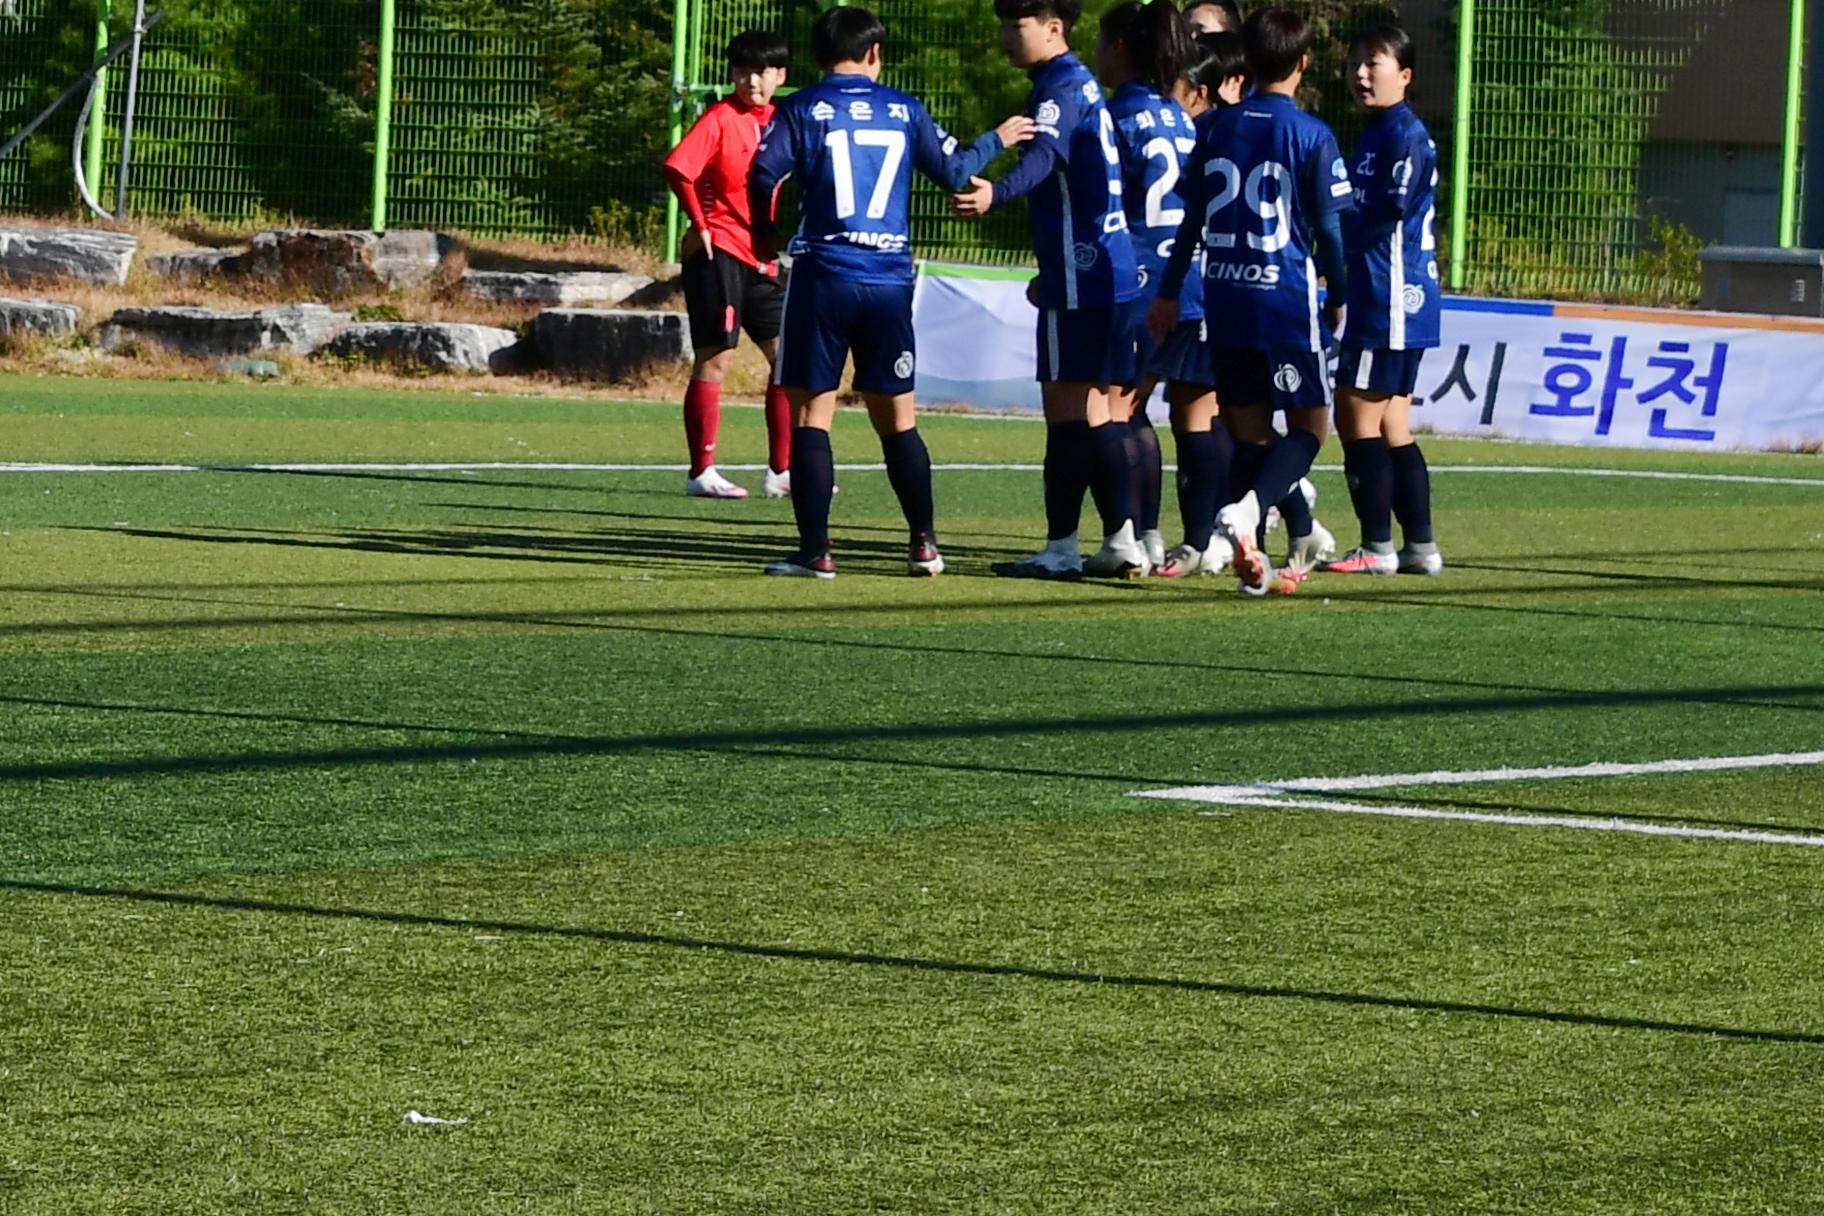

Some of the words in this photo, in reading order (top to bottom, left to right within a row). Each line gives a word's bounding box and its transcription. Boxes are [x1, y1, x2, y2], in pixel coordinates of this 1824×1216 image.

[825, 129, 907, 219] 17
[1204, 157, 1292, 253] 29
[1207, 262, 1281, 284] CINOS
[1529, 332, 1728, 441] 화천
